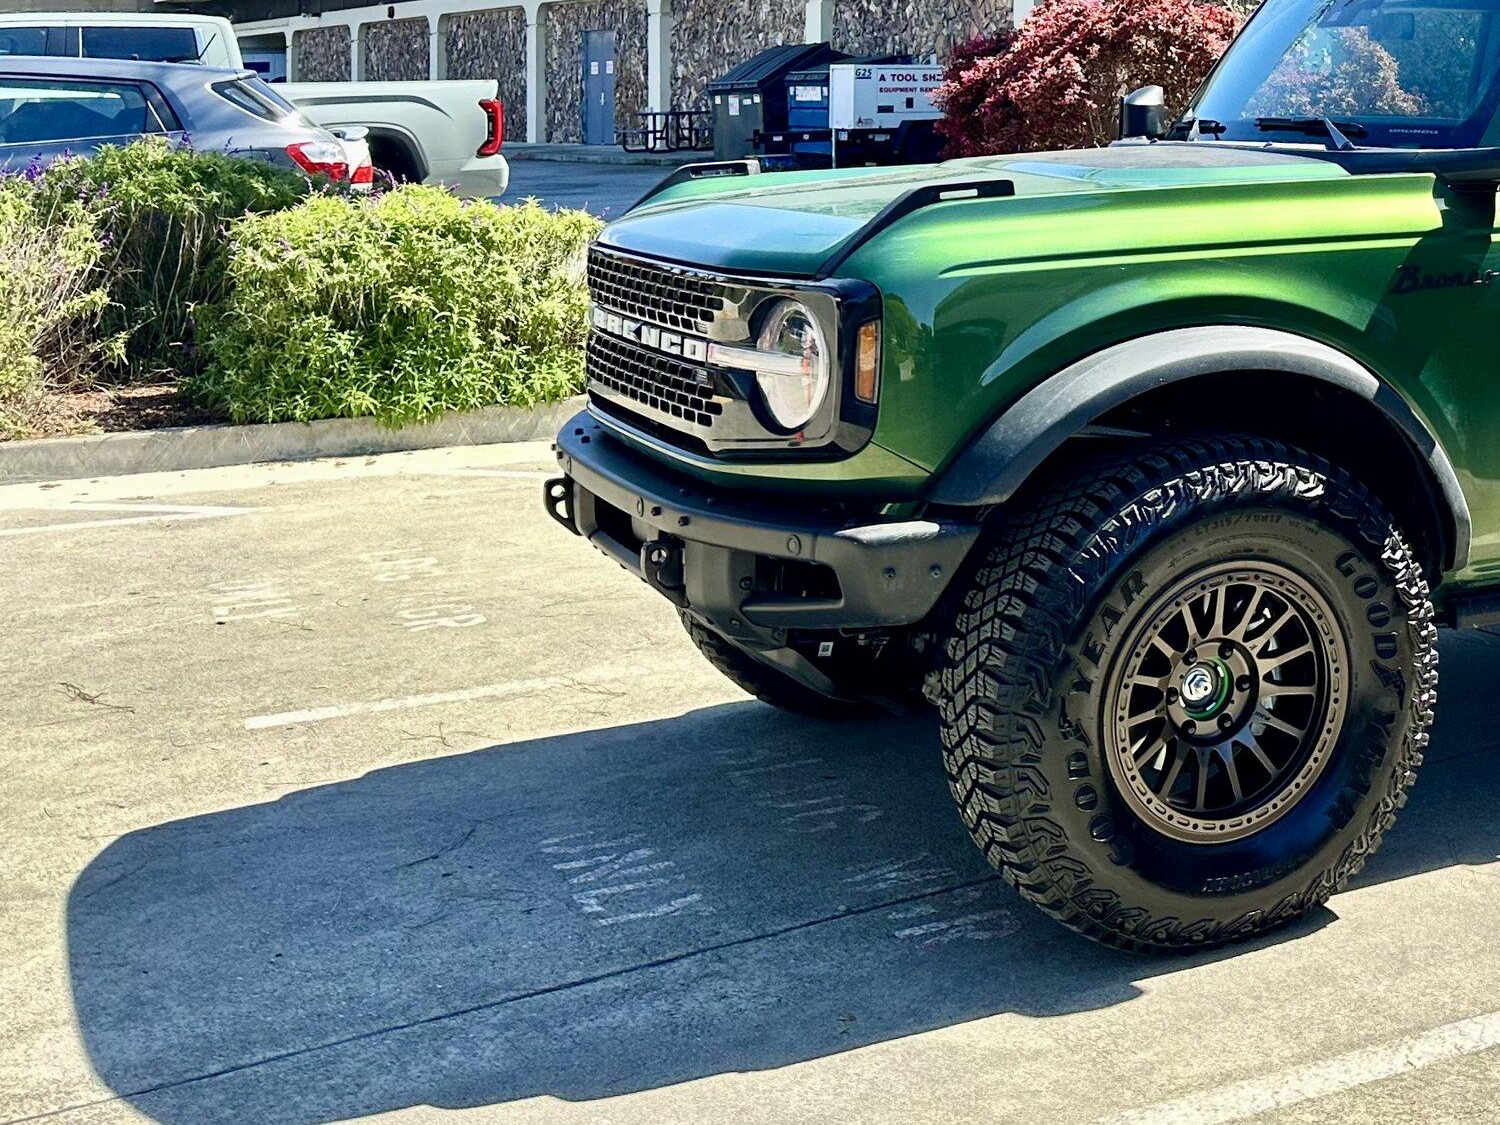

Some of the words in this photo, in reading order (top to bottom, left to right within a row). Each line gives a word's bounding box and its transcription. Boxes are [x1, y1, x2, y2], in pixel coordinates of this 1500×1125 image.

[854, 67, 873, 78] G25
[879, 73, 886, 82] A
[890, 73, 918, 82] TOOL
[922, 73, 946, 82] SHE
